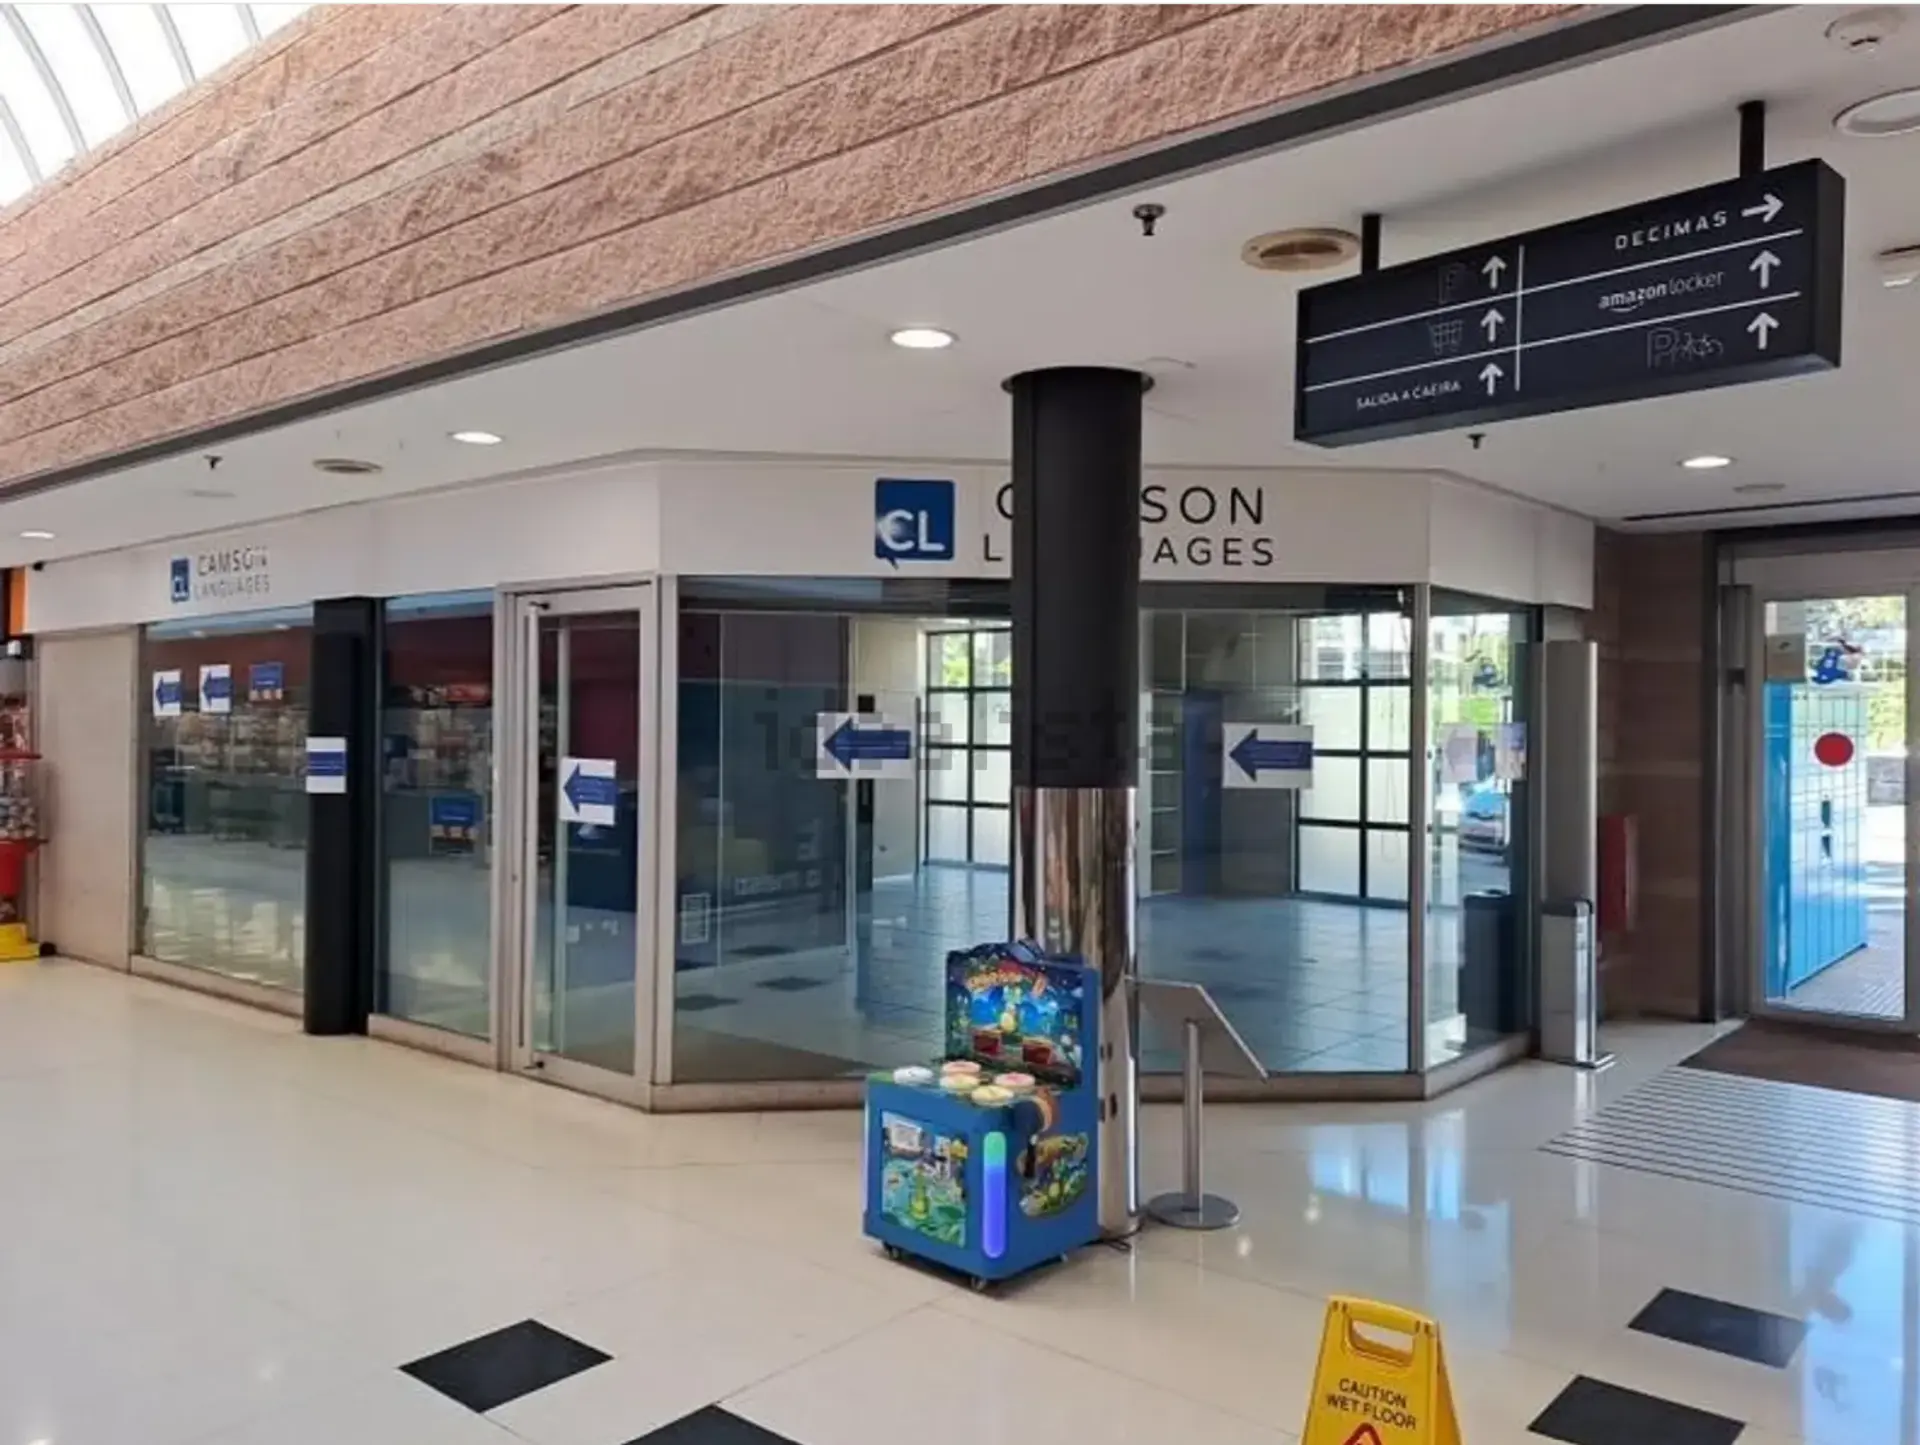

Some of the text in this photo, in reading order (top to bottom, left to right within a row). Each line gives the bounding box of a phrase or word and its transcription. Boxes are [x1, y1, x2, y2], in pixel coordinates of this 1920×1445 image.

[1614, 210, 1729, 250] DECIMAS
[1356, 391, 1399, 411] SALIDA
[1402, 390, 1411, 400] A
[197, 545, 268, 576] CAMSON
[1338, 1377, 1407, 1410] CAUTION
[1326, 1393, 1418, 1431] WET FLOOR
